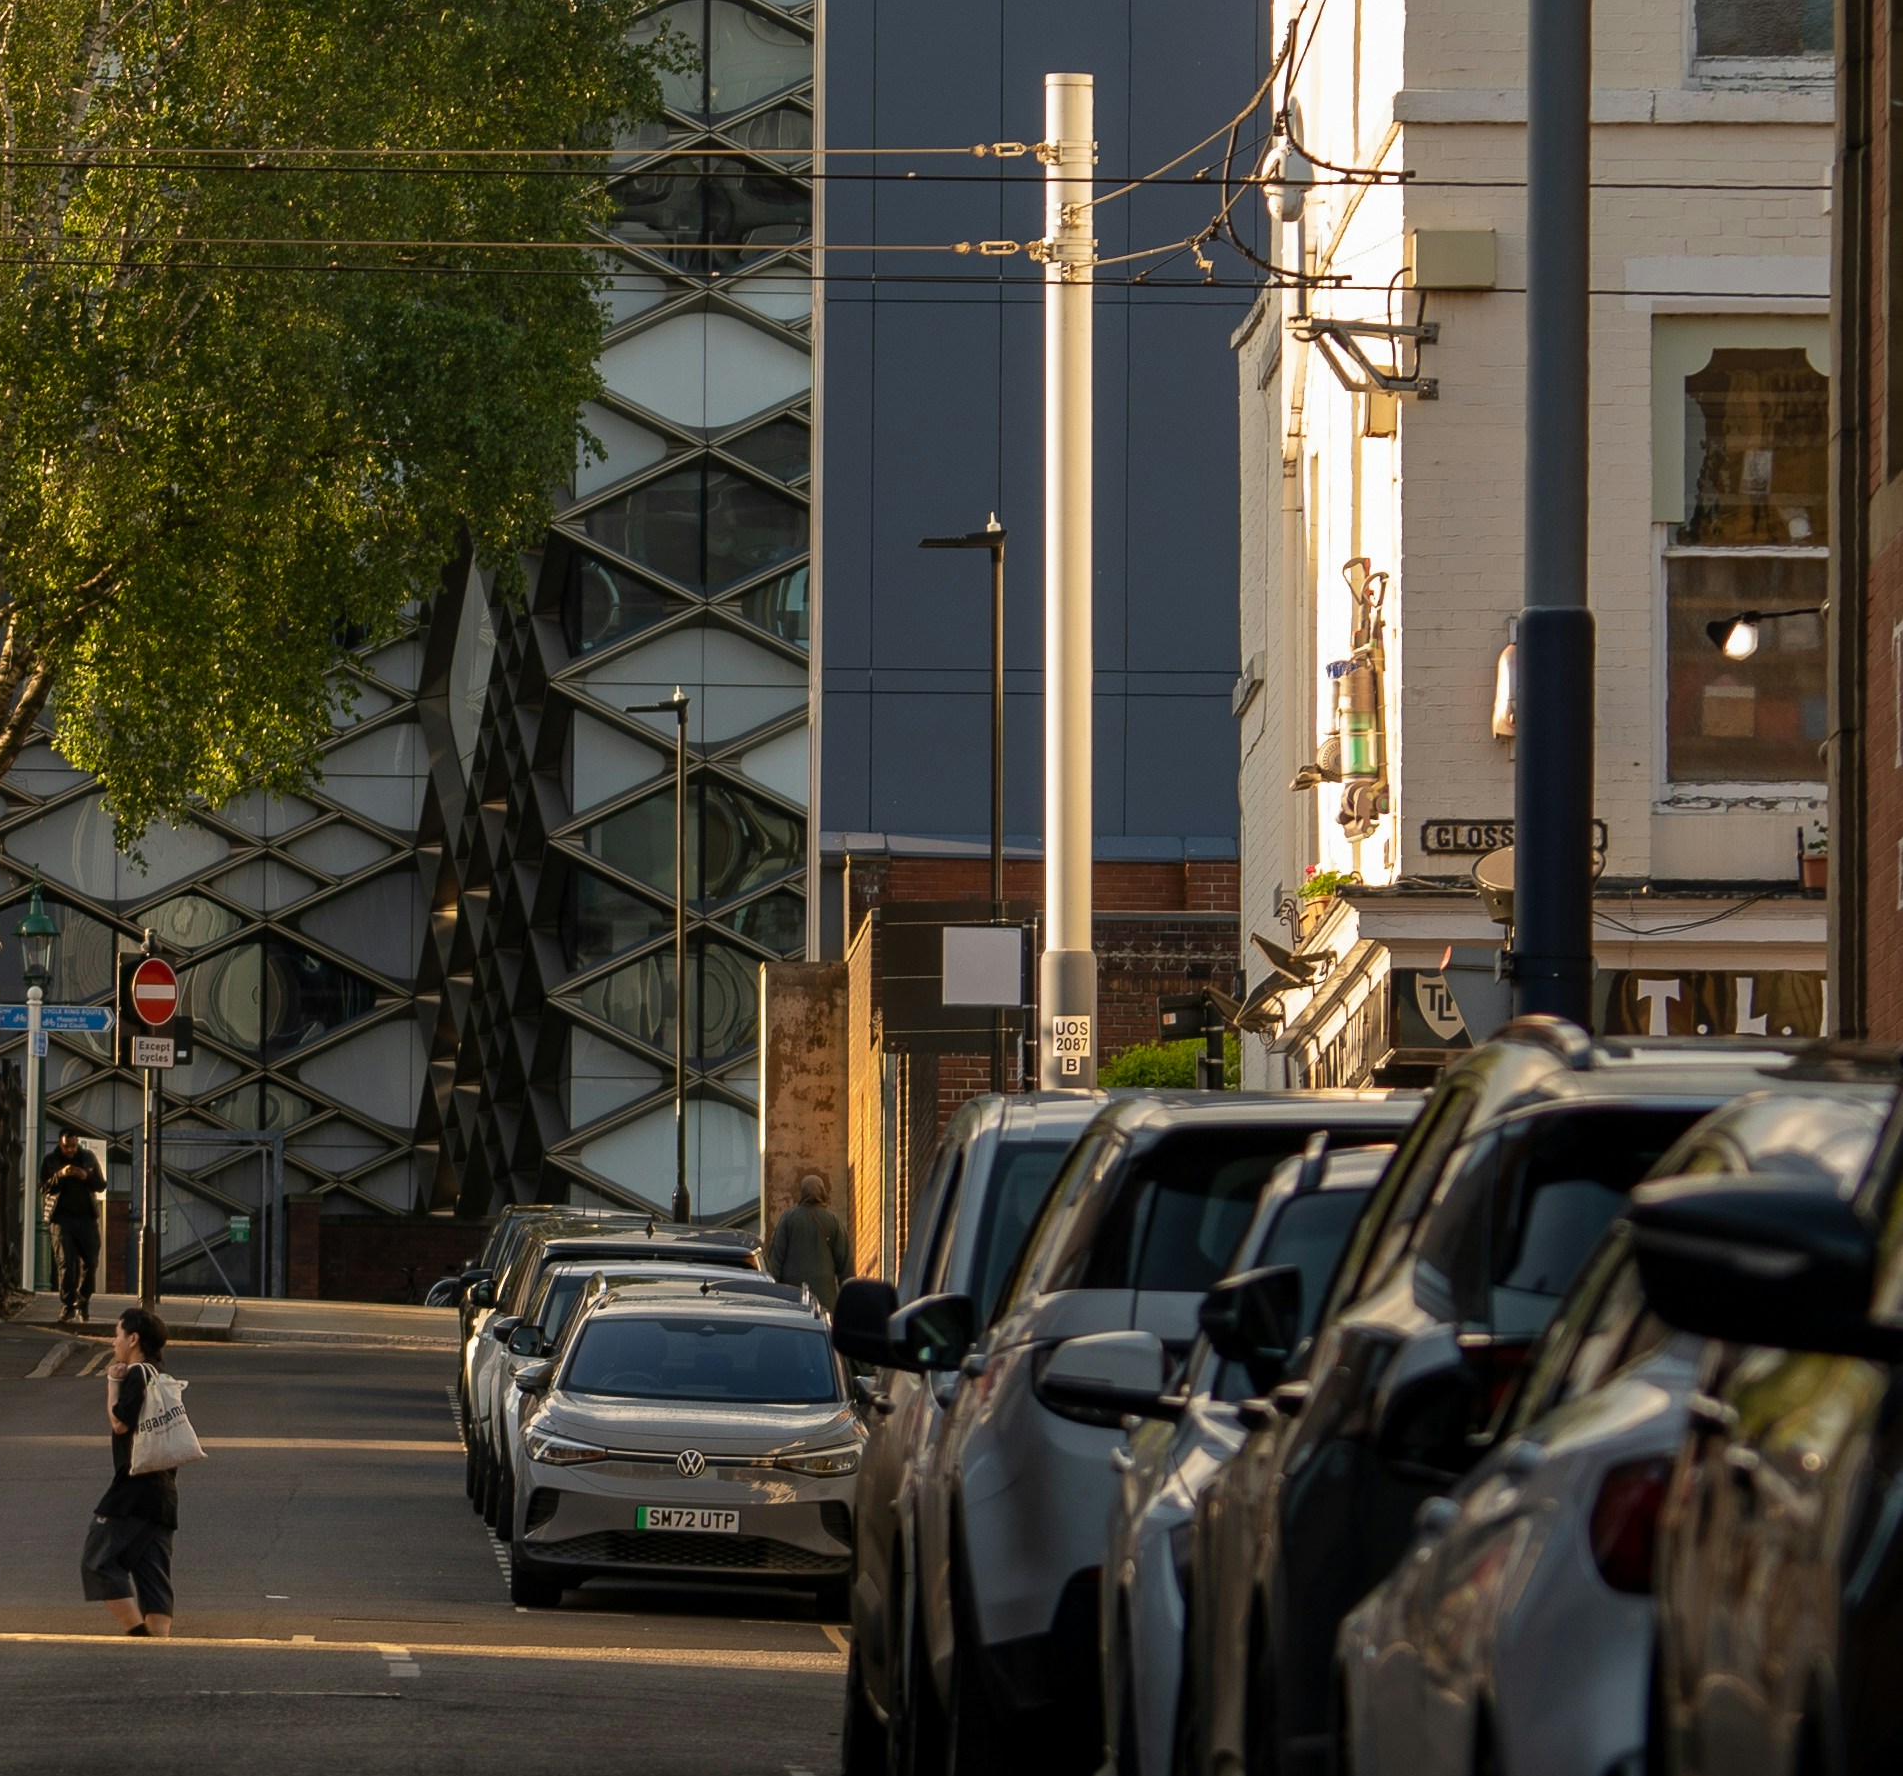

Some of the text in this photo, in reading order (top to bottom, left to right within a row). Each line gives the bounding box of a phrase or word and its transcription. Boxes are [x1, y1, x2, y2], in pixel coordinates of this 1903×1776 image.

[1436, 826, 1514, 848] GLOSS
[1637, 977, 1828, 1037] T.L.
[1056, 1022, 1088, 1036] UOS
[139, 1041, 171, 1052] Except
[1056, 1038, 1088, 1051] 2087
[140, 1053, 169, 1062] cycles
[1066, 1059, 1077, 1072] B
[649, 1509, 735, 1529] SM72 UTP
